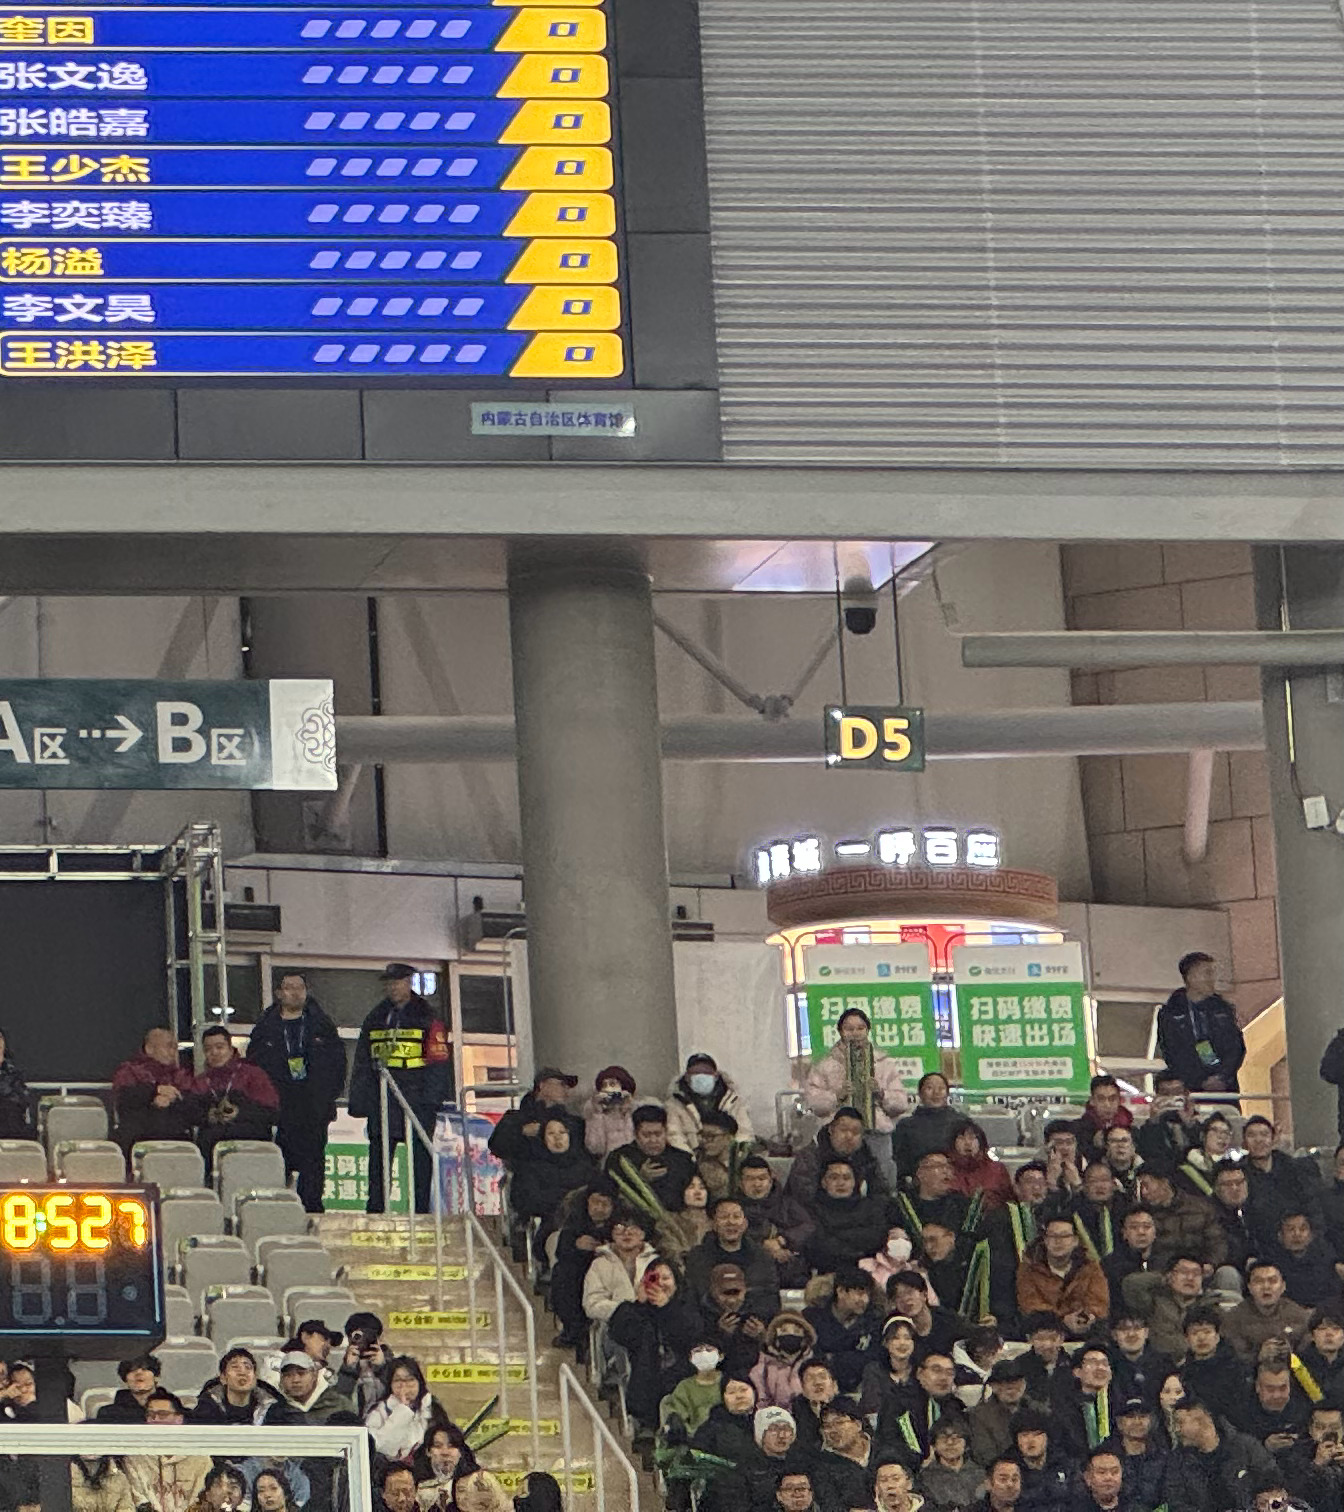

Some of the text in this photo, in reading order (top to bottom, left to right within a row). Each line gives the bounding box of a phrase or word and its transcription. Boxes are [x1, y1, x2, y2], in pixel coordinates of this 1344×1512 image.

[548, 23, 577, 37] 0
[551, 68, 579, 83] 0
[553, 114, 581, 129] 0
[555, 160, 584, 175] 0
[0, 199, 153, 230] 李奕臻
[557, 207, 586, 222] 0
[0, 246, 105, 279] 杨溢
[560, 253, 589, 268] 0
[2, 293, 156, 323] 李文昊
[562, 299, 591, 315] 0
[4, 342, 160, 373] 王洪泽
[565, 346, 593, 362] 0
[839, 715, 913, 762] D5
